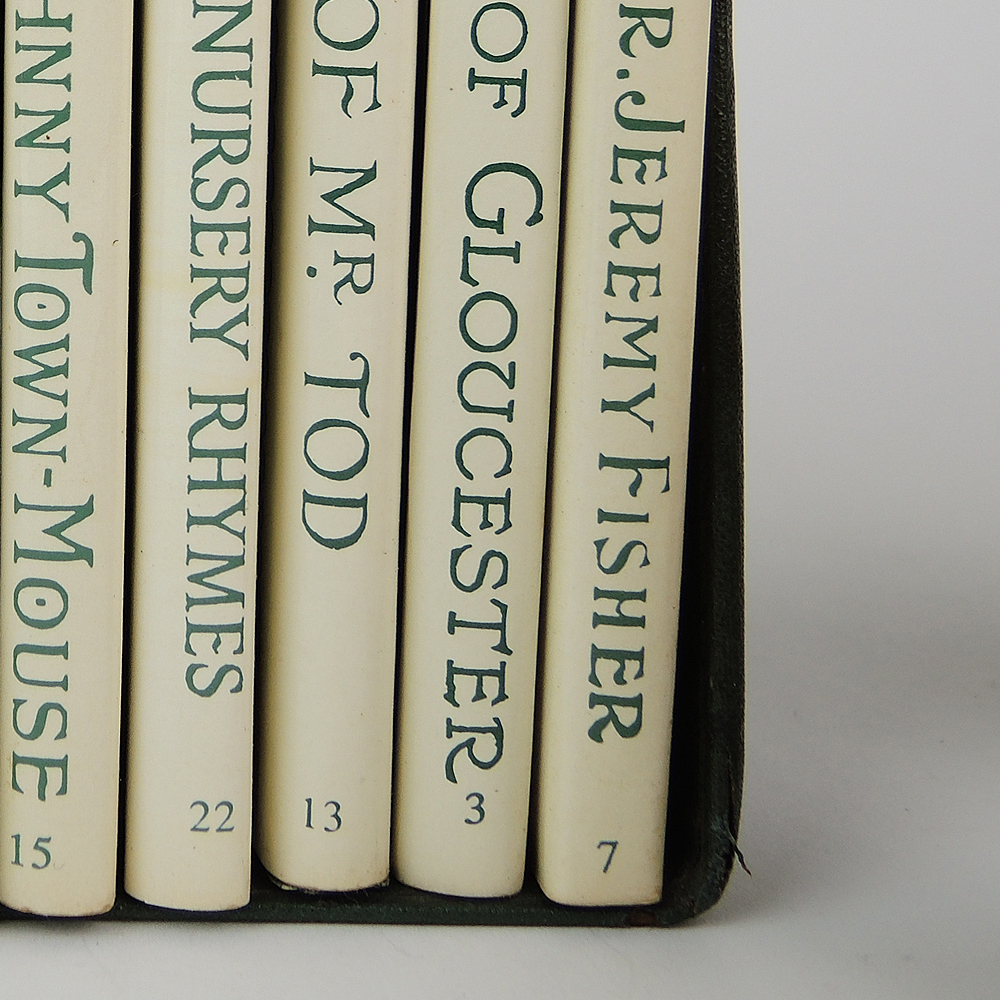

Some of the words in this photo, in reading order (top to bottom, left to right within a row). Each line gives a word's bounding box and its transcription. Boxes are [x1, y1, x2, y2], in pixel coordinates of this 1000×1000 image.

[468, 2, 528, 118] OF
[302, 352, 370, 550] TOD
[443, 162, 545, 782] GLOUCESTER
[12, 232, 92, 801] TOWN-MOUSE
[185, 387, 249, 697] RHYMES
[588, 453, 670, 743] FISHER
[11, 834, 51, 869] 15
[190, 801, 234, 832] 22
[306, 798, 341, 832] 13
[465, 792, 485, 824] 3
[597, 841, 618, 873] 7
